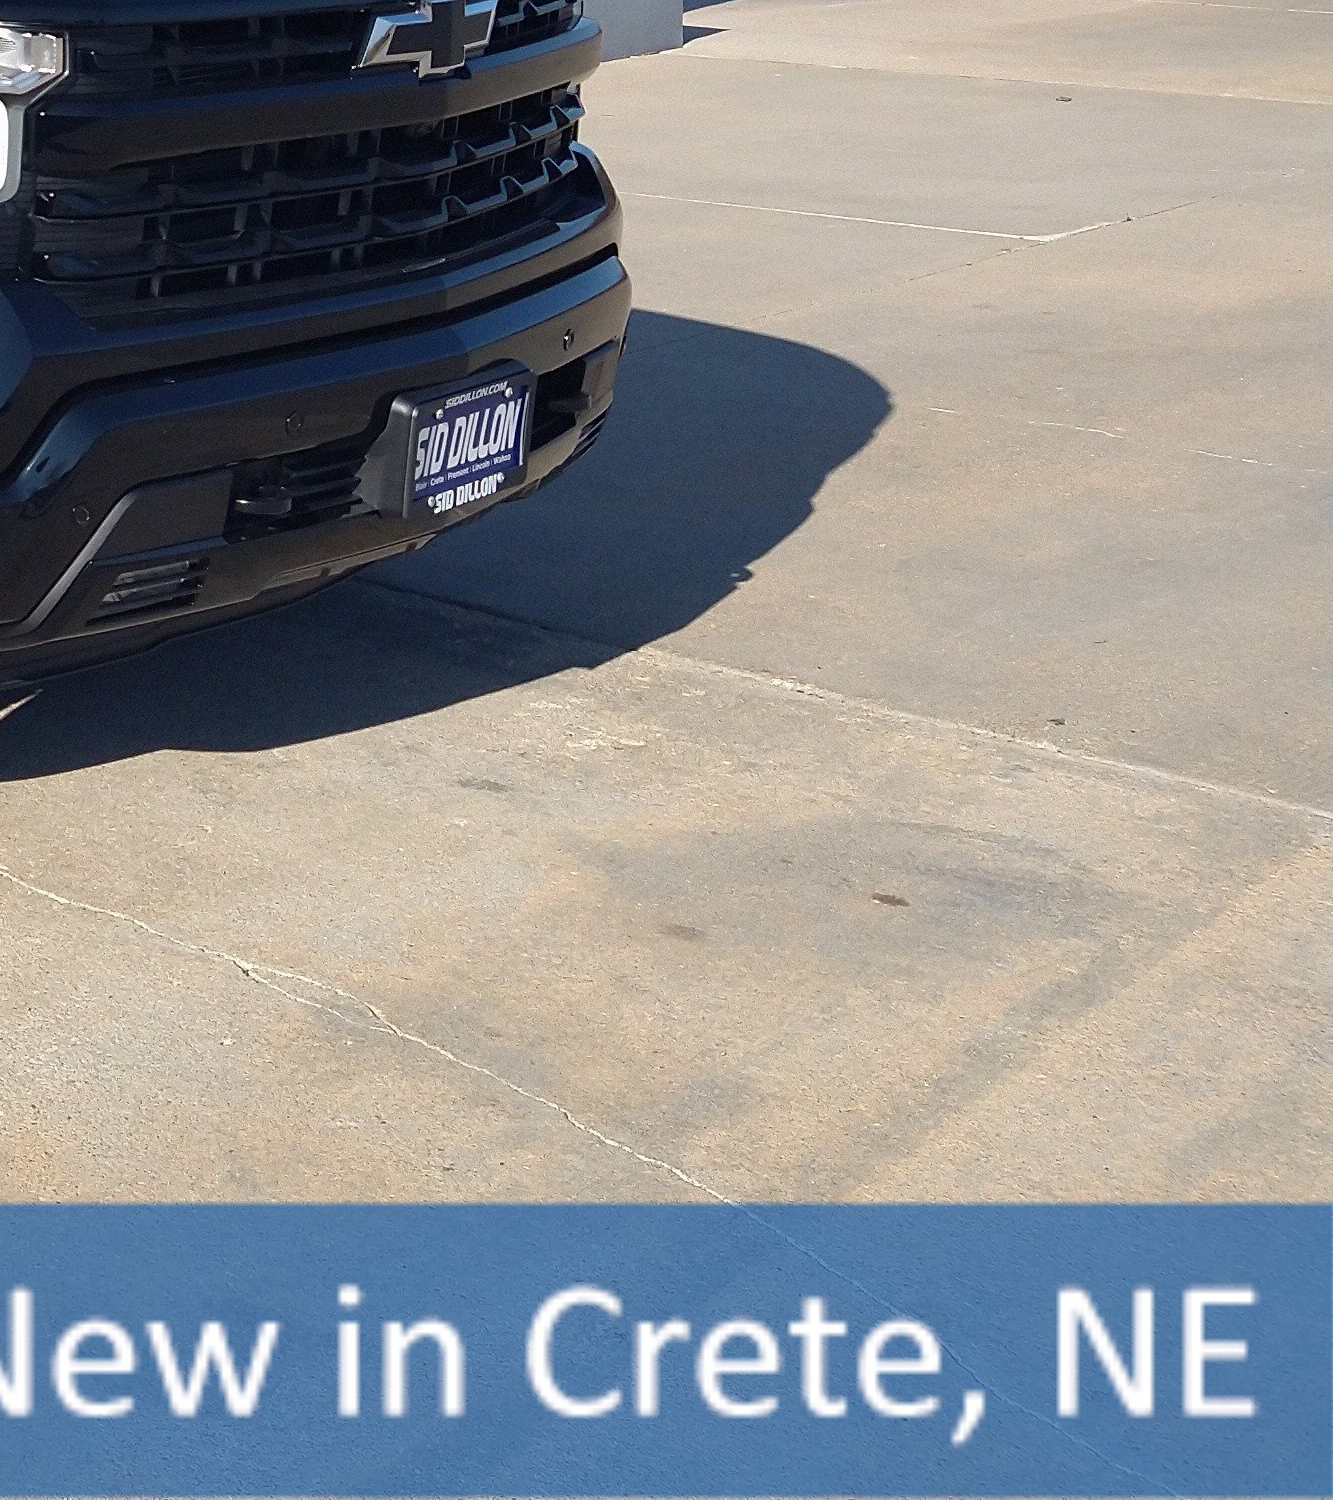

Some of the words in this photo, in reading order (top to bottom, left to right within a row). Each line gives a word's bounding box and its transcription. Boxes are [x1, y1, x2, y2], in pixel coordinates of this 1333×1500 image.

[445, 381, 508, 409] SIDDILLON.COM
[414, 422, 449, 480] SID
[447, 398, 523, 469] DILLON
[434, 490, 454, 514] SID
[456, 473, 497, 506] DILLON
